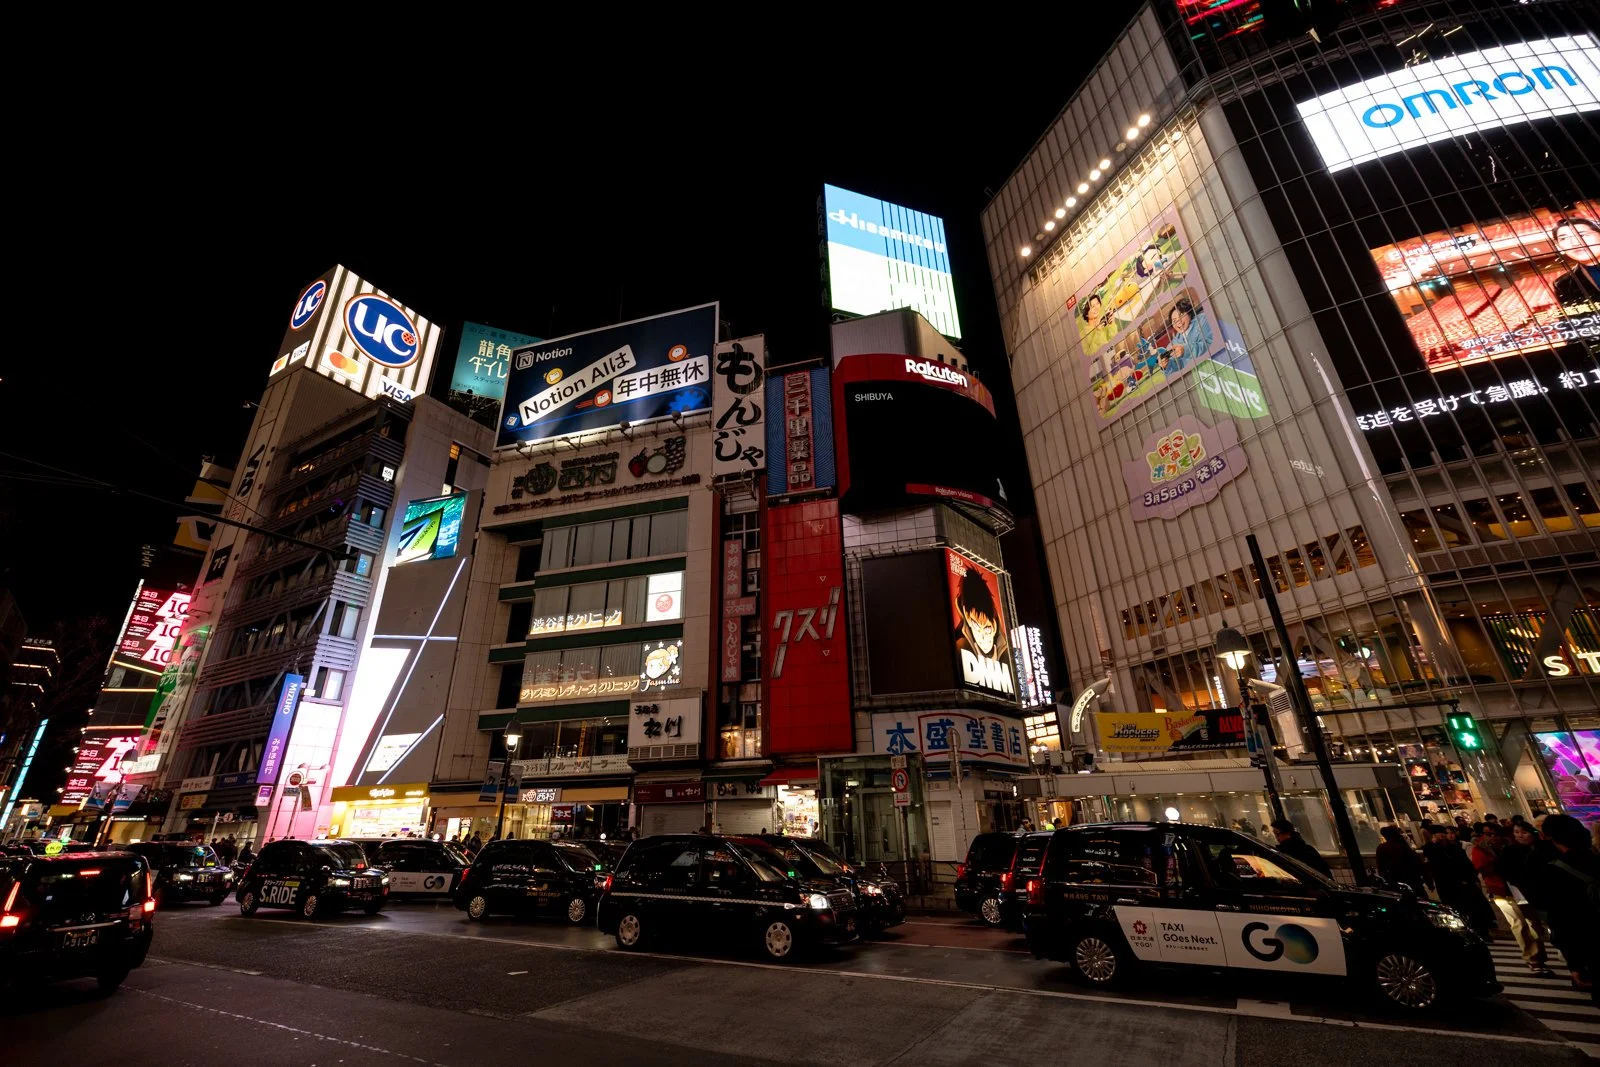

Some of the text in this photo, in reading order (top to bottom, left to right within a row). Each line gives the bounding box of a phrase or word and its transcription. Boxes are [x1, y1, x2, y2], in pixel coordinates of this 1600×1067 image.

[828, 209, 946, 253] Hisamitsu
[295, 287, 323, 320] UC
[353, 302, 412, 357] UC
[468, 356, 508, 379] ダイレ
[535, 347, 573, 363] Notion
[616, 360, 704, 398] 年中無休
[905, 358, 968, 387] Rakuten
[381, 380, 413, 402] VISA
[523, 377, 587, 420] Notion
[714, 342, 764, 467] もんじゃ
[855, 392, 894, 402] SHIBUYA
[786, 372, 811, 485] 三千里薬品
[935, 486, 973, 499] Rakuten Vision
[771, 586, 841, 679] クスリ
[961, 648, 1014, 694] DMM
[282, 682, 298, 715] MIZUHO
[886, 718, 1022, 756] 大盛堂書店
[264, 738, 281, 775] みずほ銀行
[259, 885, 299, 904] S.RIDE
[423, 875, 445, 890] GO
[1161, 922, 1184, 932] TAXI
[1163, 933, 1218, 945] GOes Next.
[1241, 921, 1319, 964] GO
